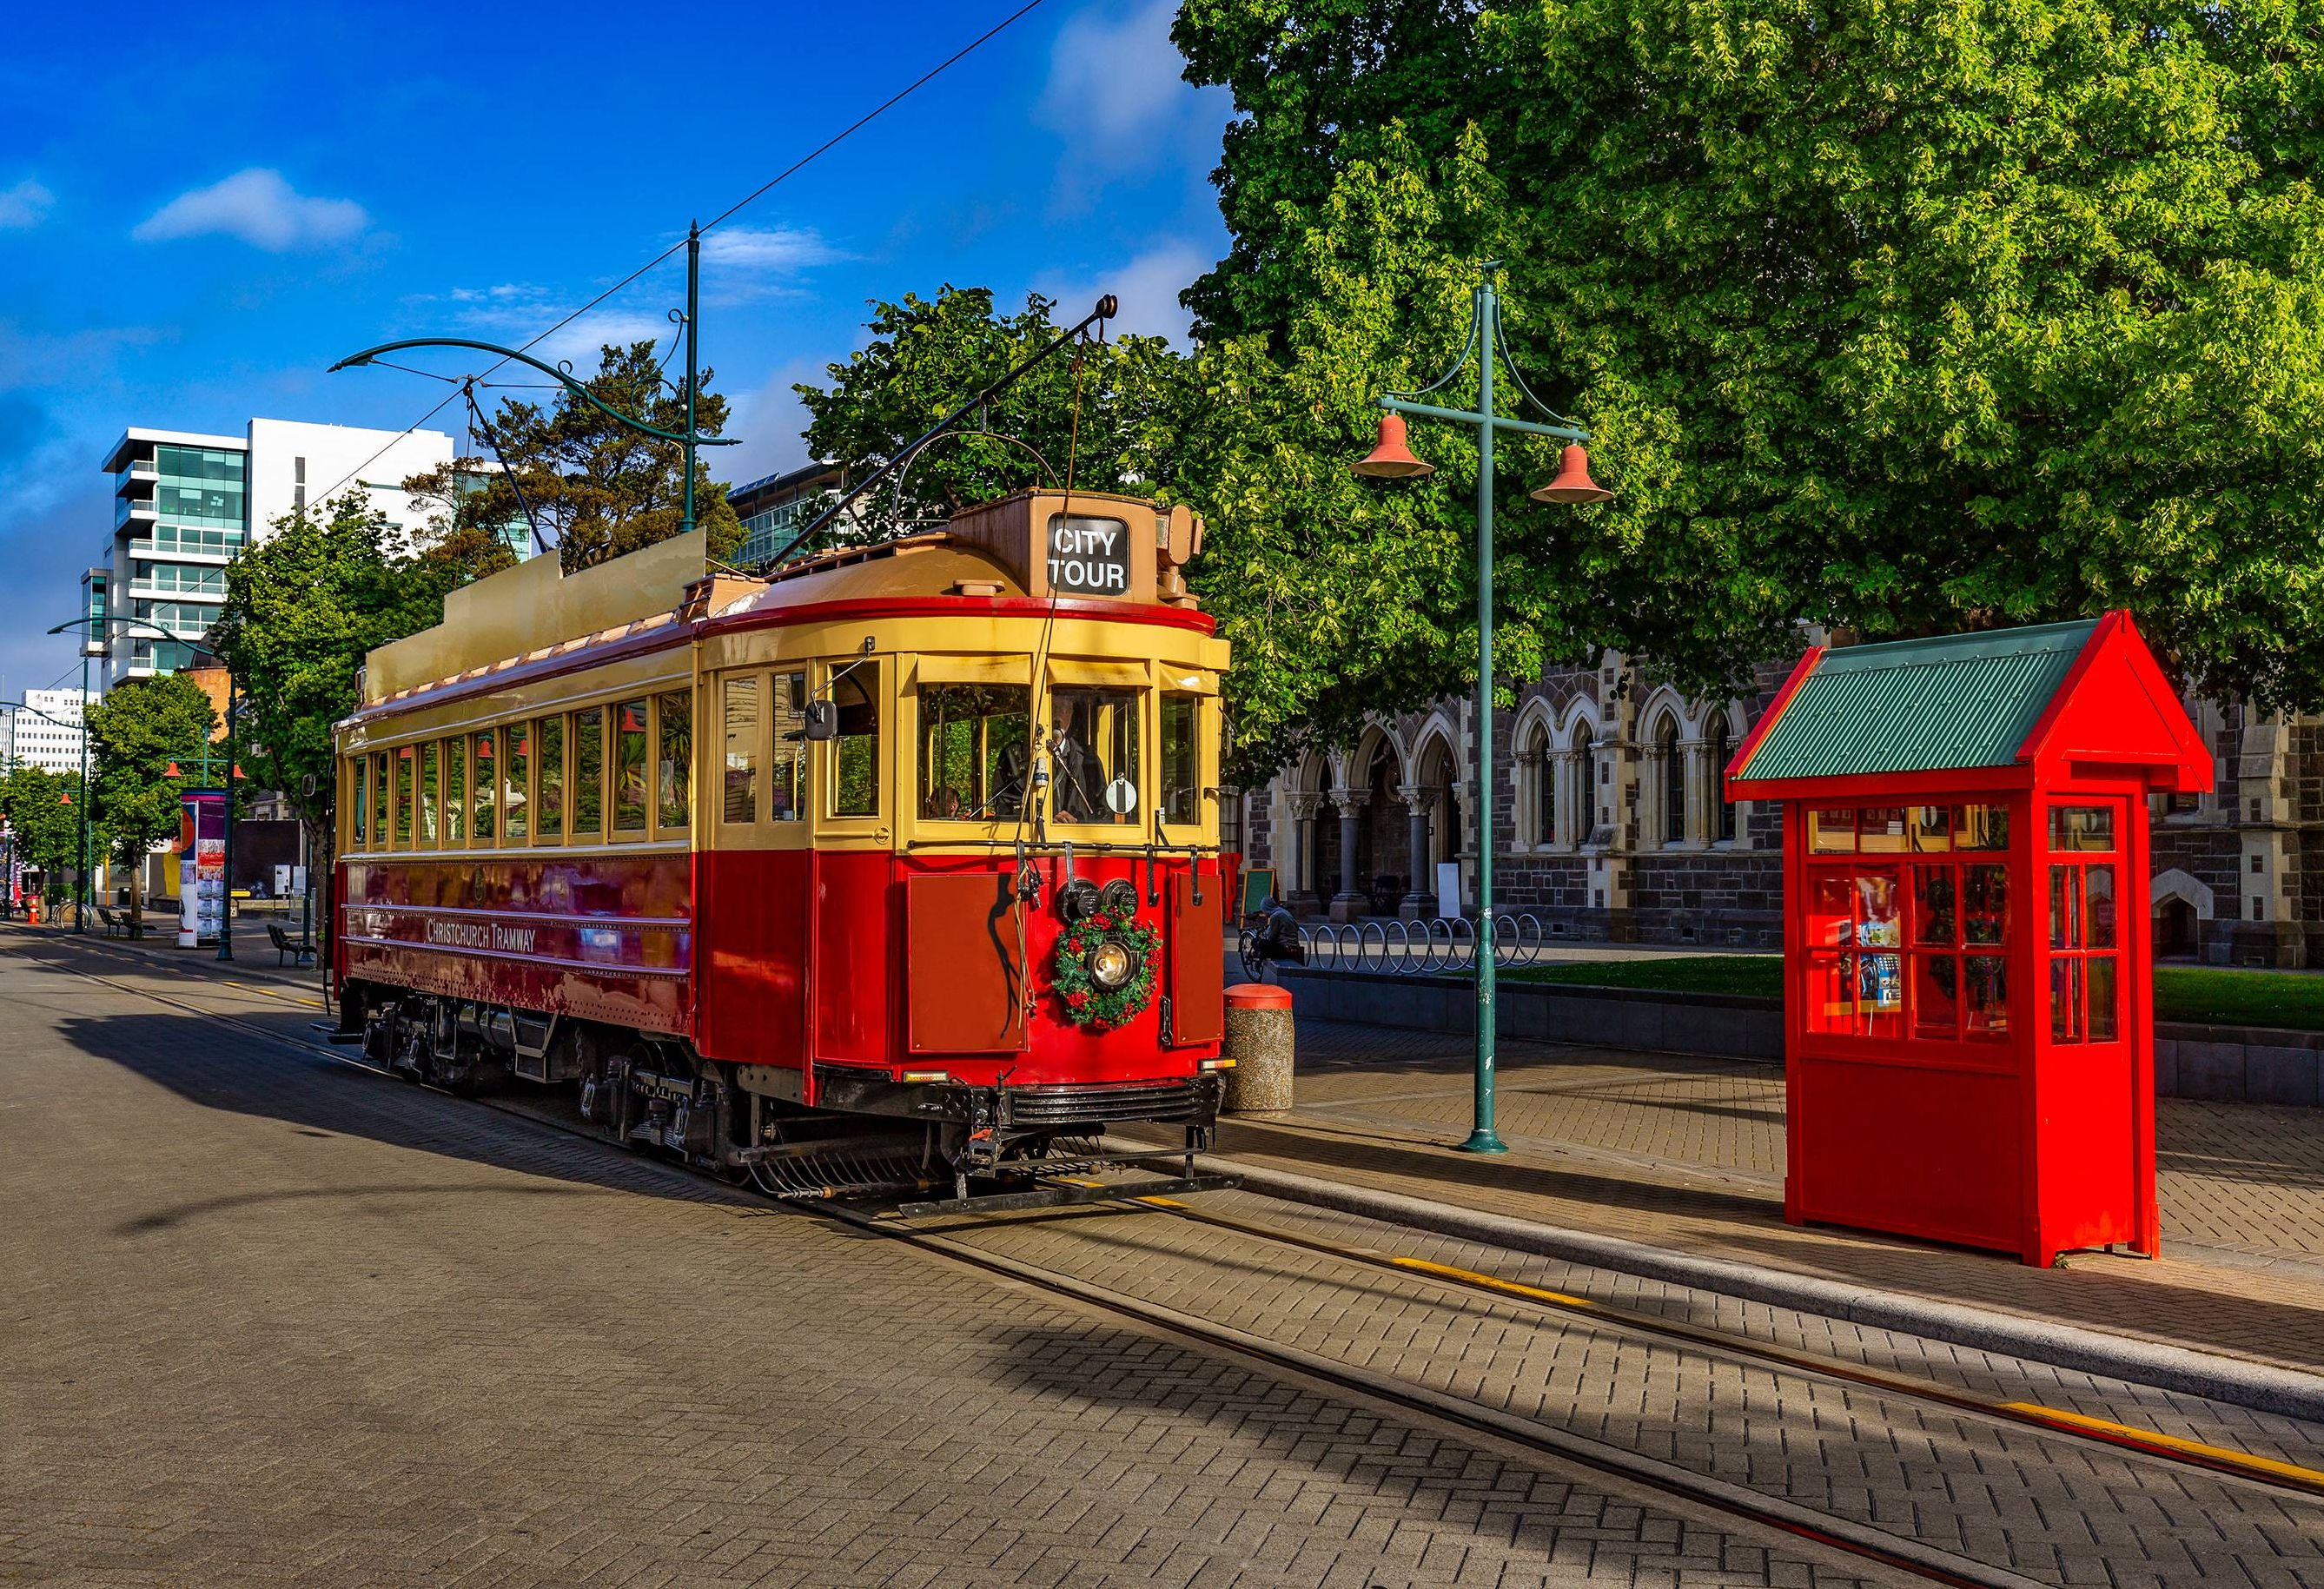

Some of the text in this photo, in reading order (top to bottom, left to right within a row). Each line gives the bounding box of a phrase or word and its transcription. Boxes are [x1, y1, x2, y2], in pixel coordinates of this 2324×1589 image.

[1054, 527, 1117, 556] CITY
[1048, 559, 1125, 588] TOUR
[427, 917, 536, 953] CHRISTCHURCH TRAMWAY
